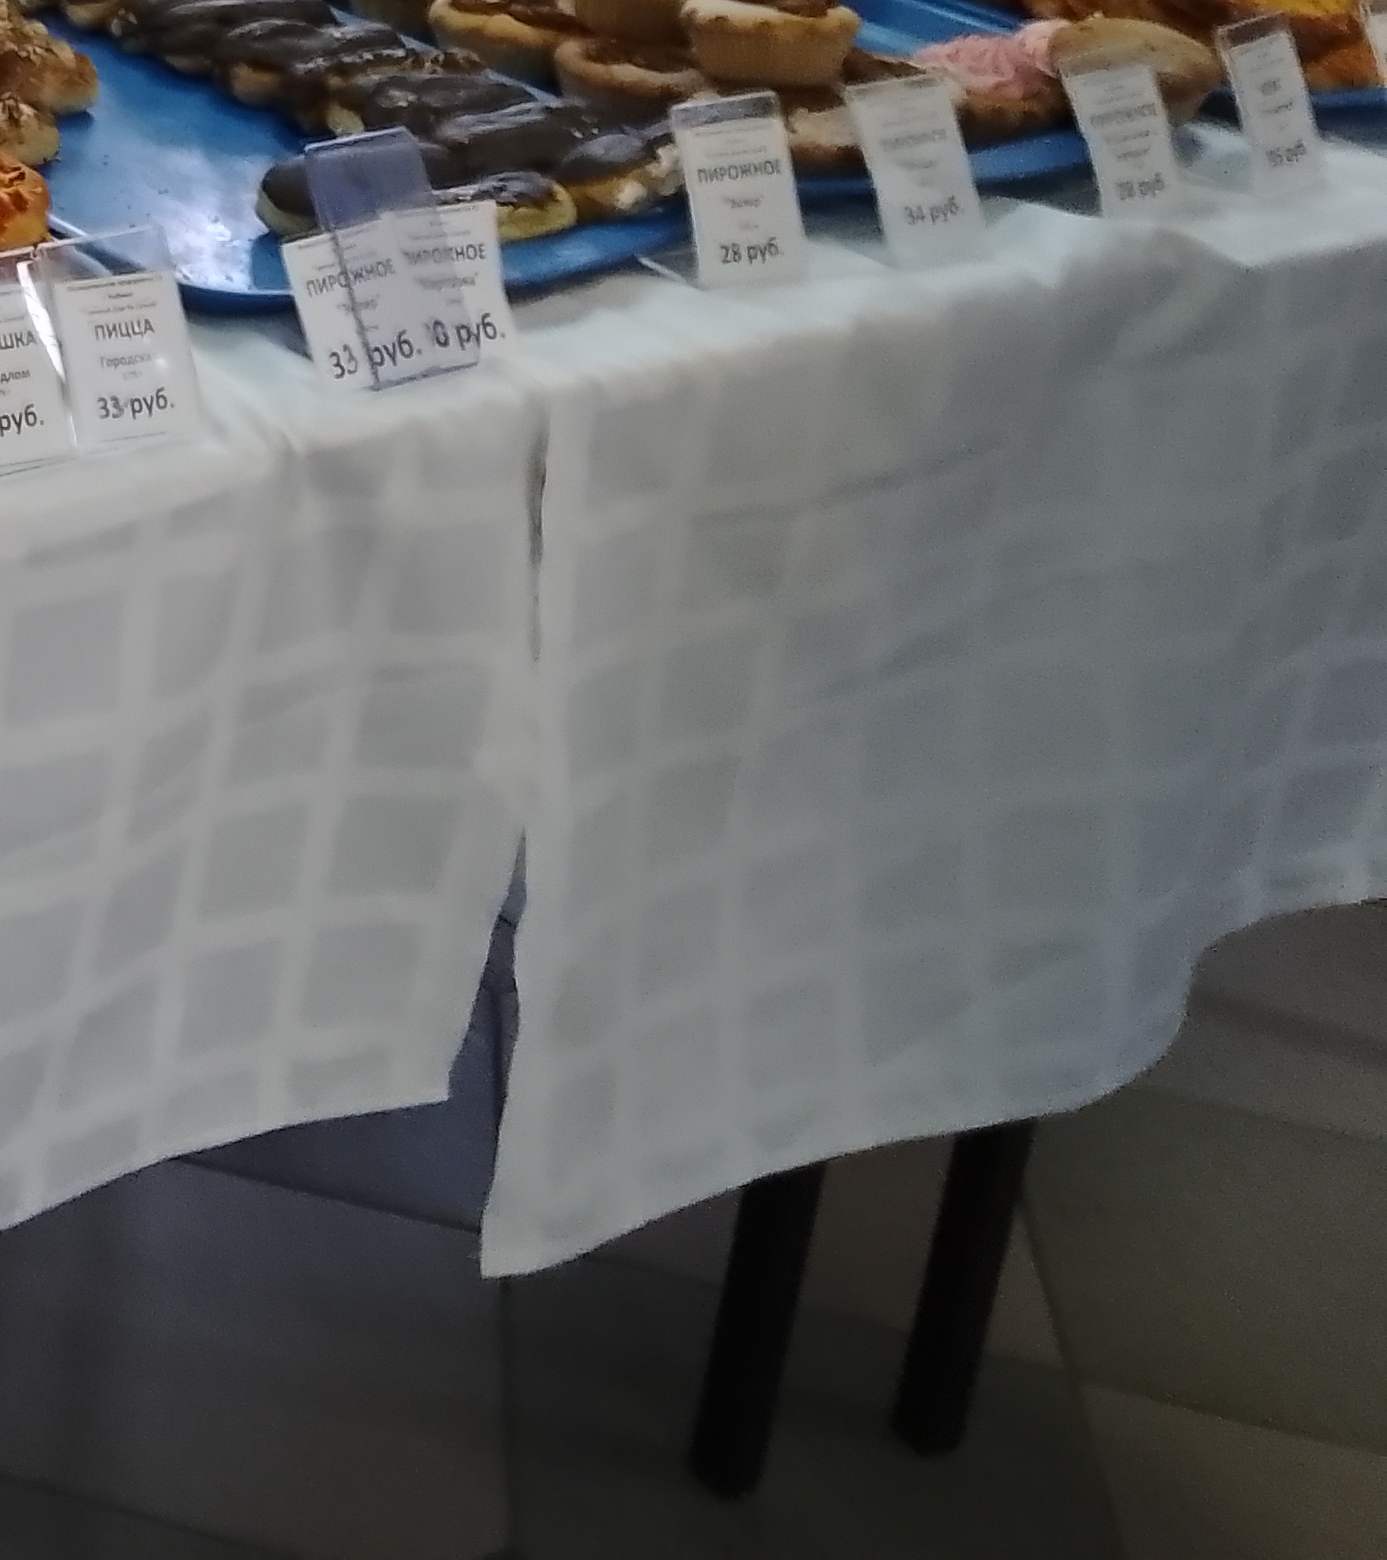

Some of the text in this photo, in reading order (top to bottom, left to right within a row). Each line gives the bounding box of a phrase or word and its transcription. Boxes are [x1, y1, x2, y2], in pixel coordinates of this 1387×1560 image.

[719, 242, 743, 265] 28
[305, 258, 396, 299] ПИРОЖНОЕ
[94, 317, 156, 342] ПИЦЦА
[455, 312, 506, 351] руб.
[100, 352, 156, 369] Городска
[328, 328, 423, 380] 33 руб.
[96, 386, 176, 421] 33 руб.
